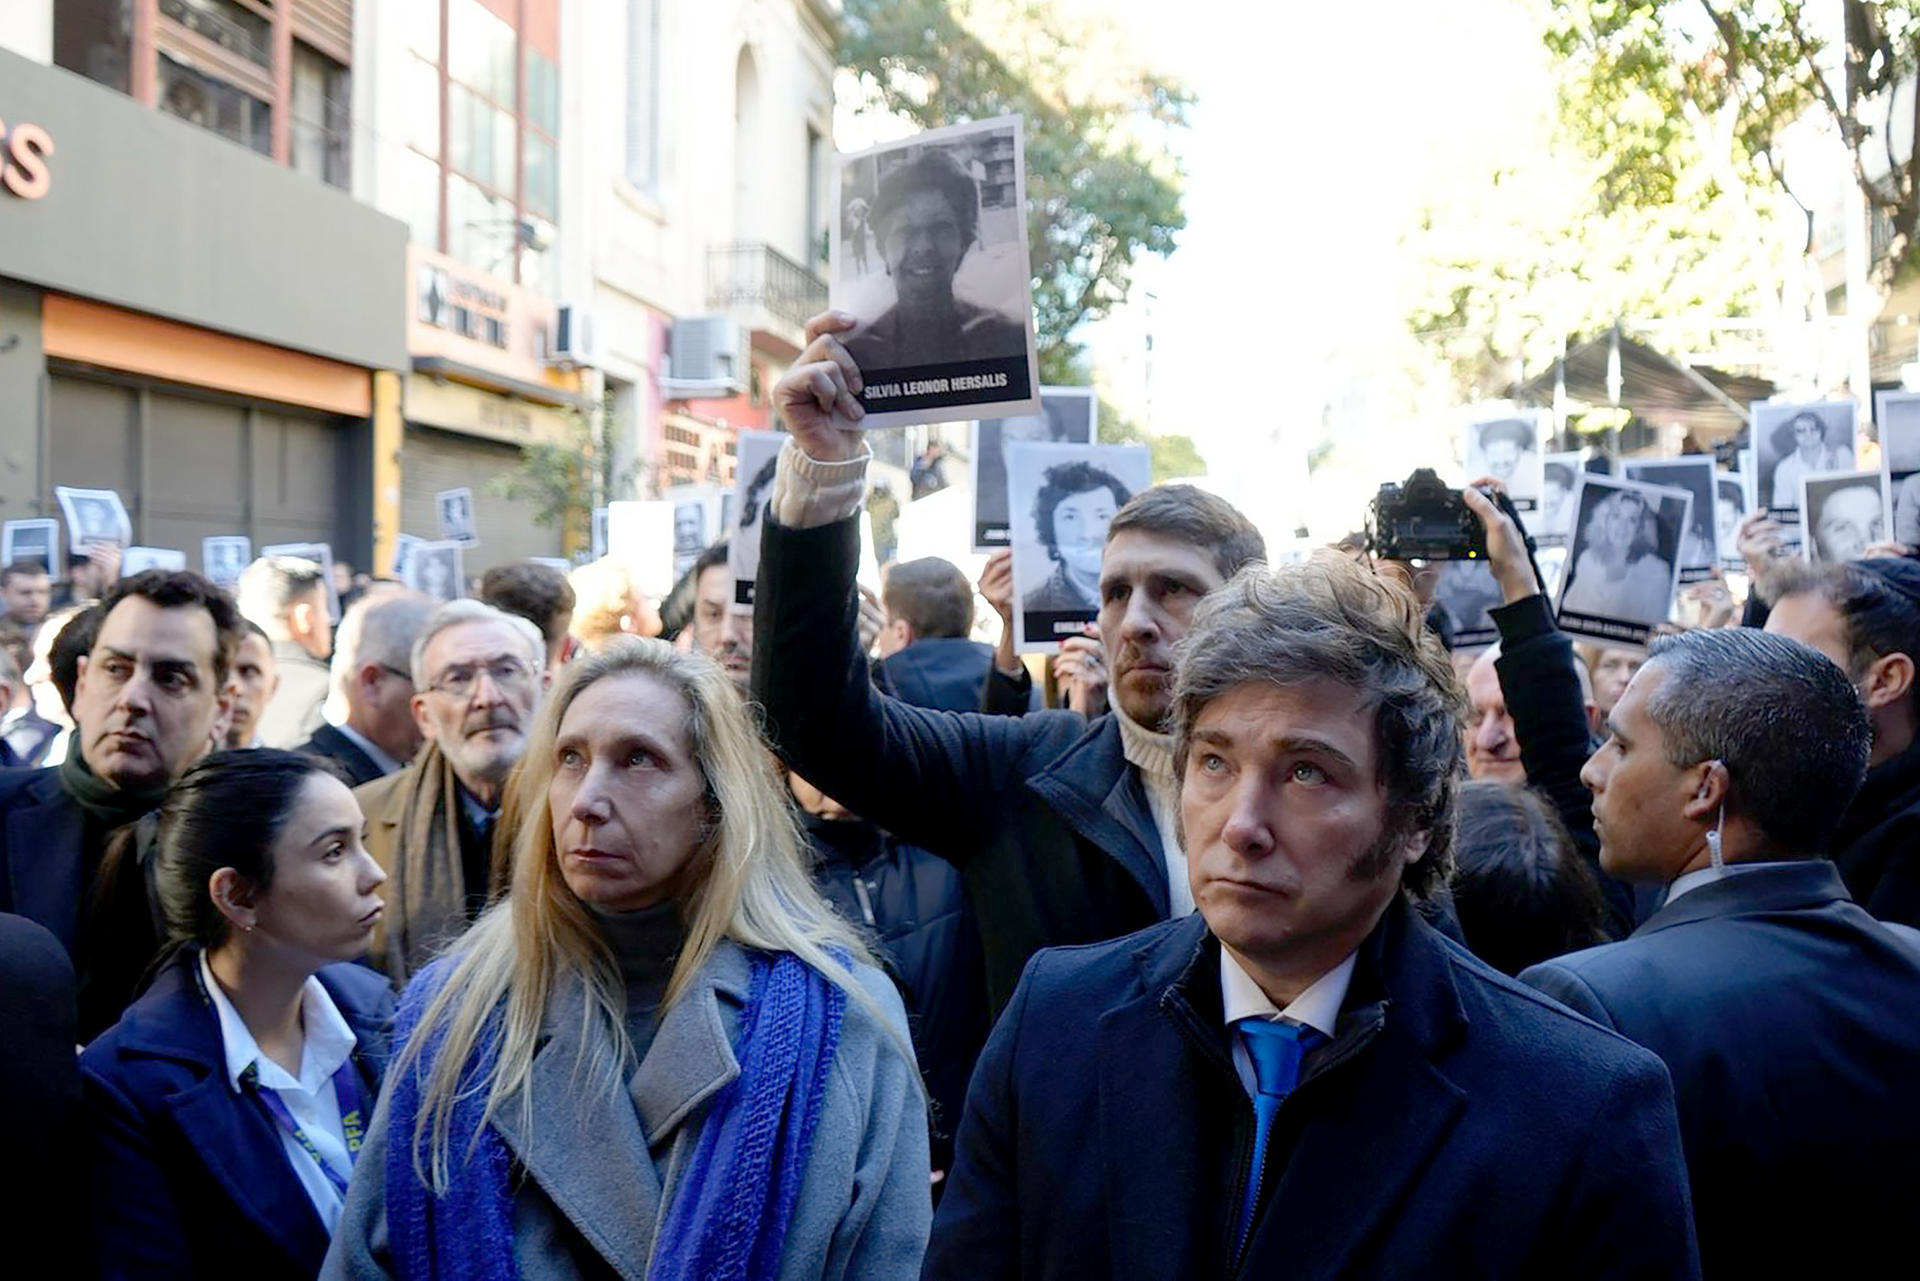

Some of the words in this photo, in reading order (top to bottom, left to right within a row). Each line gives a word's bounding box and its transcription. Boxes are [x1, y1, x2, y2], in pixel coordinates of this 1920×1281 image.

[864, 382, 902, 399] SILVIA
[903, 378, 949, 396] LEONOR
[951, 372, 1008, 391] HERSALIS
[342, 1109, 363, 1152] PFA
